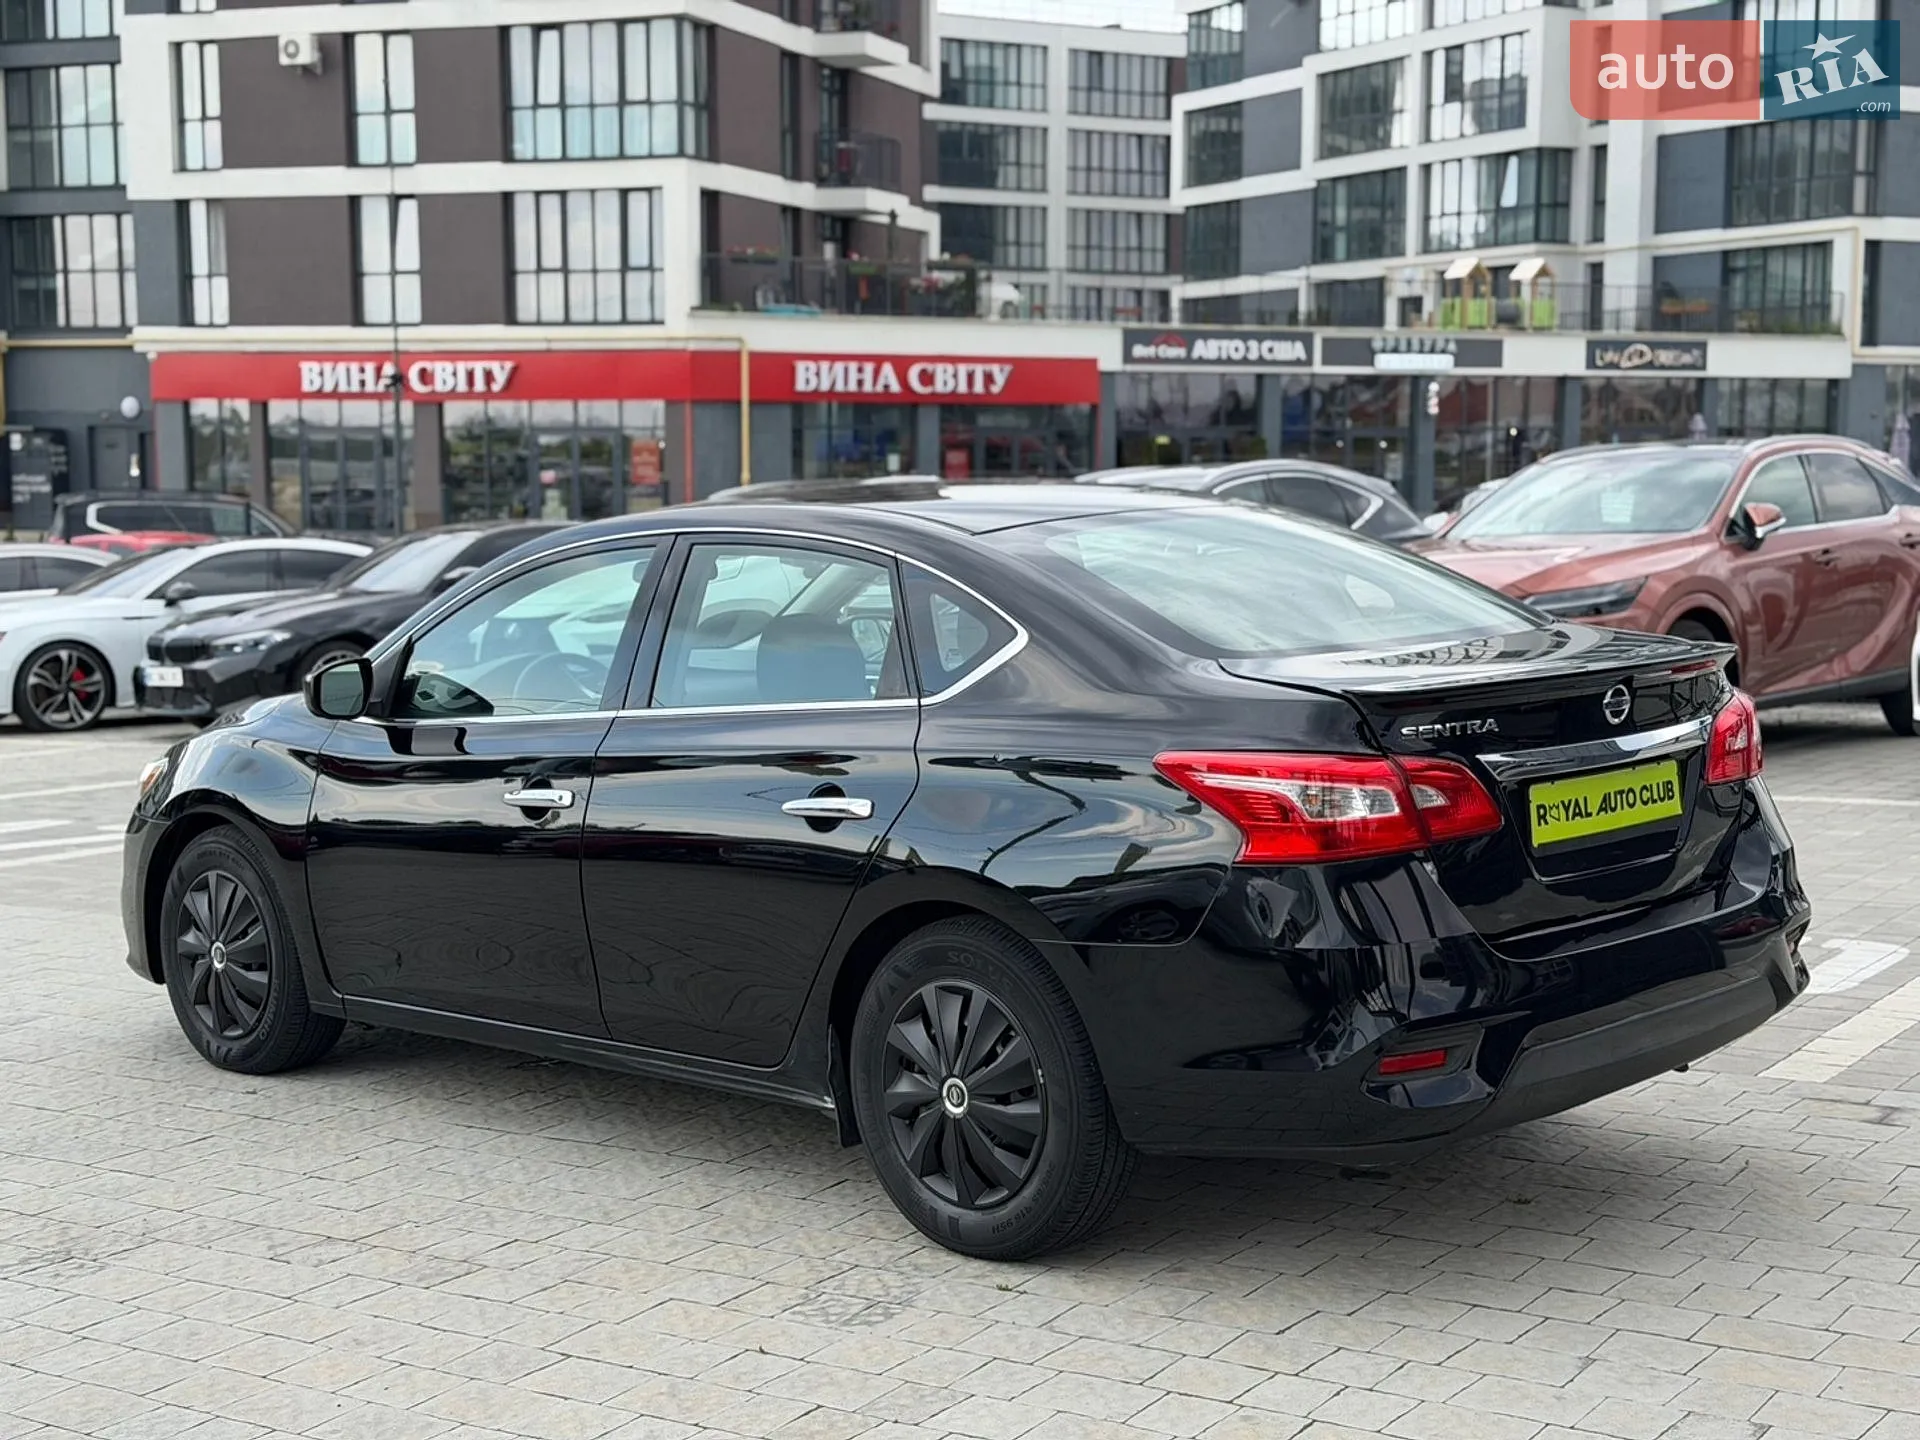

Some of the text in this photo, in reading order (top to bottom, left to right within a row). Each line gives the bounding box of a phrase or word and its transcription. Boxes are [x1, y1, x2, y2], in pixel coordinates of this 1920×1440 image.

[1191, 338, 1246, 361] АВТО
[299, 360, 516, 393] ВИНА СВІТУ
[794, 360, 1014, 394] ВИНА СВІТУ
[1401, 718, 1500, 740] SENTRA
[1596, 787, 1637, 817] AUTO
[1638, 779, 1675, 807] CLUB
